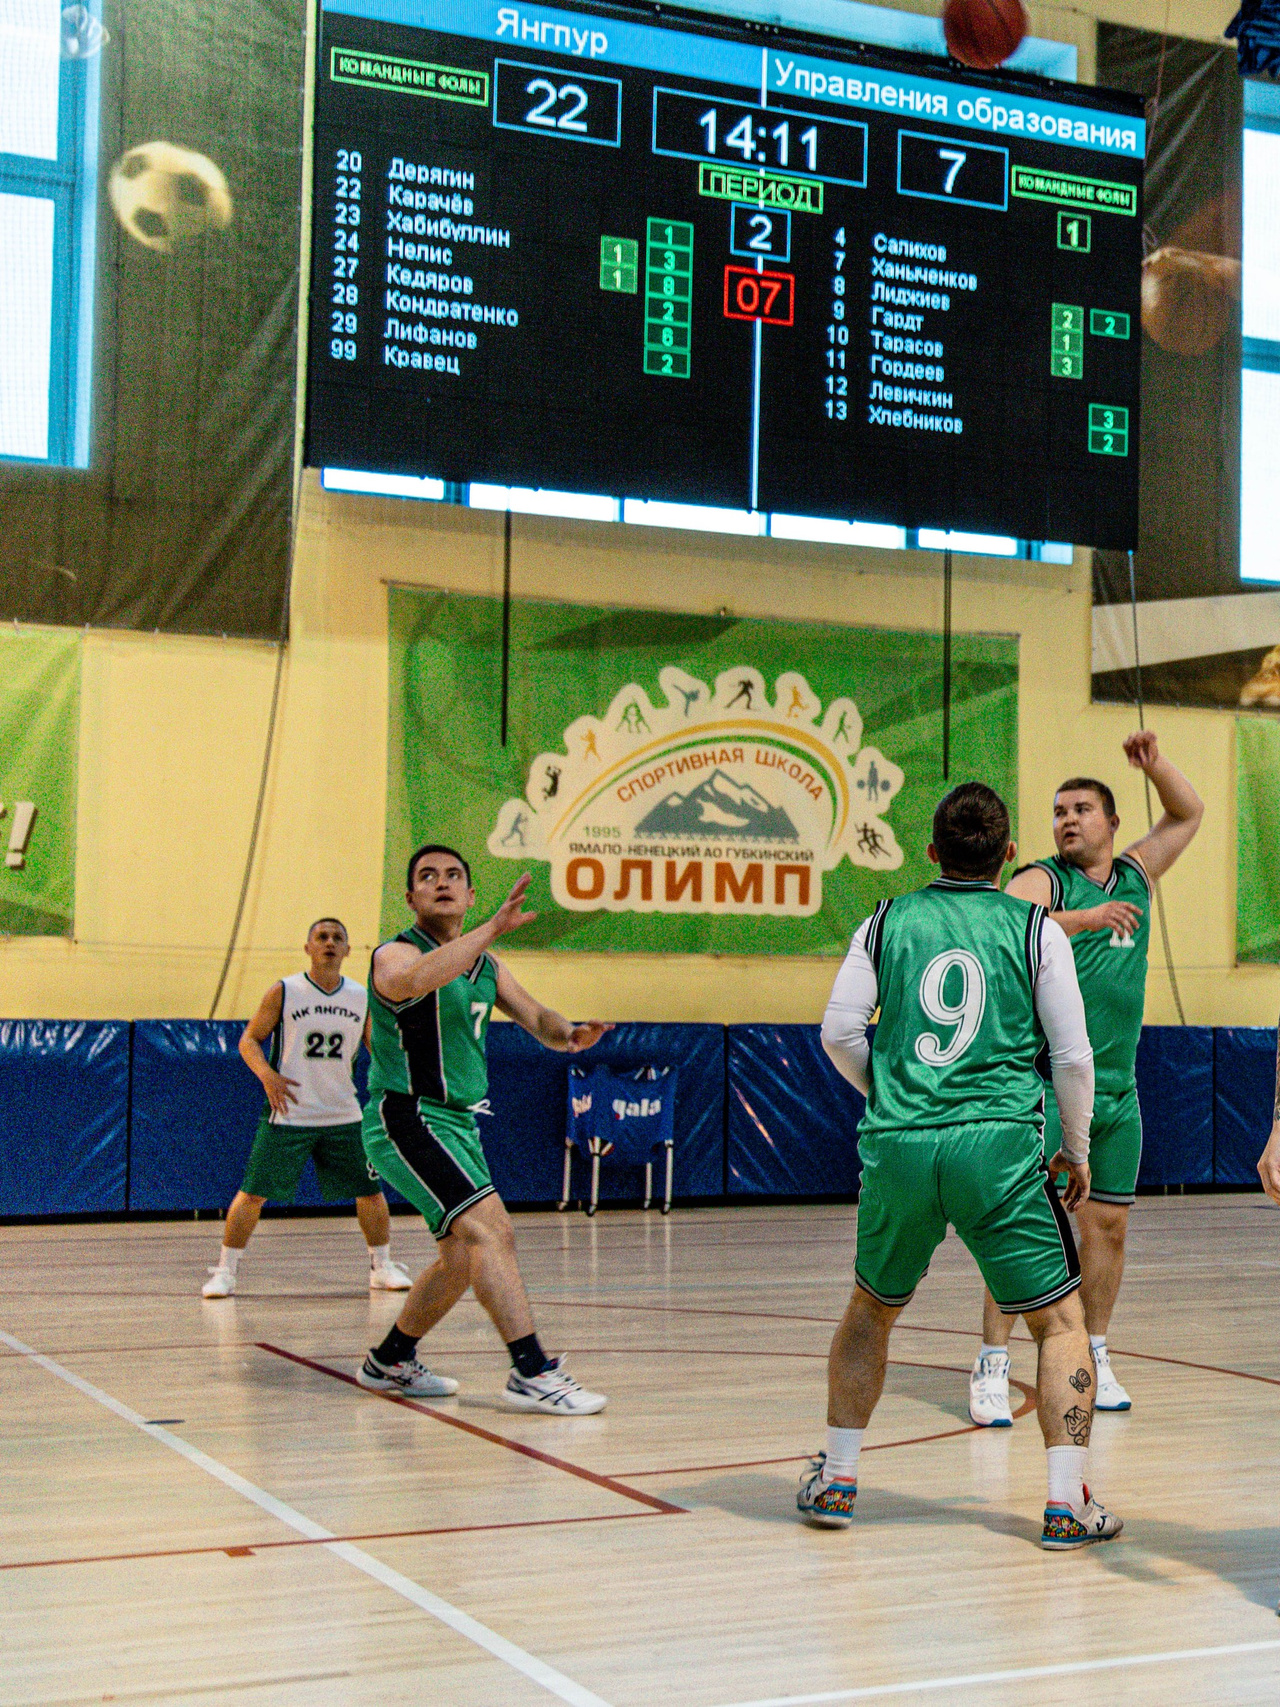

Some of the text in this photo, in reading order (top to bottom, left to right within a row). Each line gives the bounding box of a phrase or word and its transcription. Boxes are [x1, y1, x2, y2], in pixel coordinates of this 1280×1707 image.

[496, 8, 608, 56] Янгпур
[339, 56, 481, 95] КОМАНДНЫЕ ФОЛЫ
[526, 79, 588, 132] 22
[775, 58, 1137, 151] Управления образования
[700, 107, 819, 171] 14:11
[336, 149, 474, 190] 20 Дерягин
[938, 149, 967, 193] 7
[336, 176, 474, 216] 22 Карачёв
[709, 171, 813, 208] ПЕРИОД
[1019, 174, 1130, 207] КОМАНДНЫЕ ФОЛЫ
[335, 202, 510, 248] 23 Хабибуллин
[665, 226, 673, 246] 1
[750, 214, 772, 251] 2
[1066, 220, 1078, 248] 1
[334, 229, 453, 266] 24 Нелис
[614, 244, 622, 264] 1
[664, 251, 675, 271] 3
[834, 227, 946, 262] 4 Салихов
[334, 256, 474, 295] 27 Кедяров
[613, 269, 621, 289] 1
[833, 275, 845, 296] 8
[834, 251, 978, 291] 7 Ханыченков
[332, 282, 519, 327] 28 Кондратенко
[663, 302, 674, 322] 2
[736, 277, 782, 315] 07
[332, 310, 477, 350] 29 Лифанов
[833, 300, 924, 332] 9 Гардт
[1062, 310, 1073, 330] 2
[1105, 317, 1116, 336] 2
[331, 338, 461, 376] 99 Кравец
[826, 324, 943, 358] 10 Тарасов
[1062, 334, 1071, 351] 1
[661, 354, 673, 374] 2
[826, 348, 944, 382] 11 Гордеев
[1062, 356, 1072, 376] 3
[825, 375, 953, 409] 12 Левичкин
[824, 400, 964, 434] 13 Хлебников
[1104, 411, 1114, 430] 3
[1103, 434, 1114, 452] 2
[616, 748, 823, 803] СПОРТИВНАЯ ШКОЛА
[583, 826, 621, 838] 1995
[704, 848, 722, 859] АО
[726, 848, 814, 863] ГУБКИНСКИЙ
[566, 856, 811, 907] ОЛИМП
[292, 1007, 310, 1020] НК
[471, 1003, 487, 1039] 7
[914, 948, 987, 1067] 9
[305, 1031, 344, 1060] 22
[612, 1098, 662, 1120] gala
